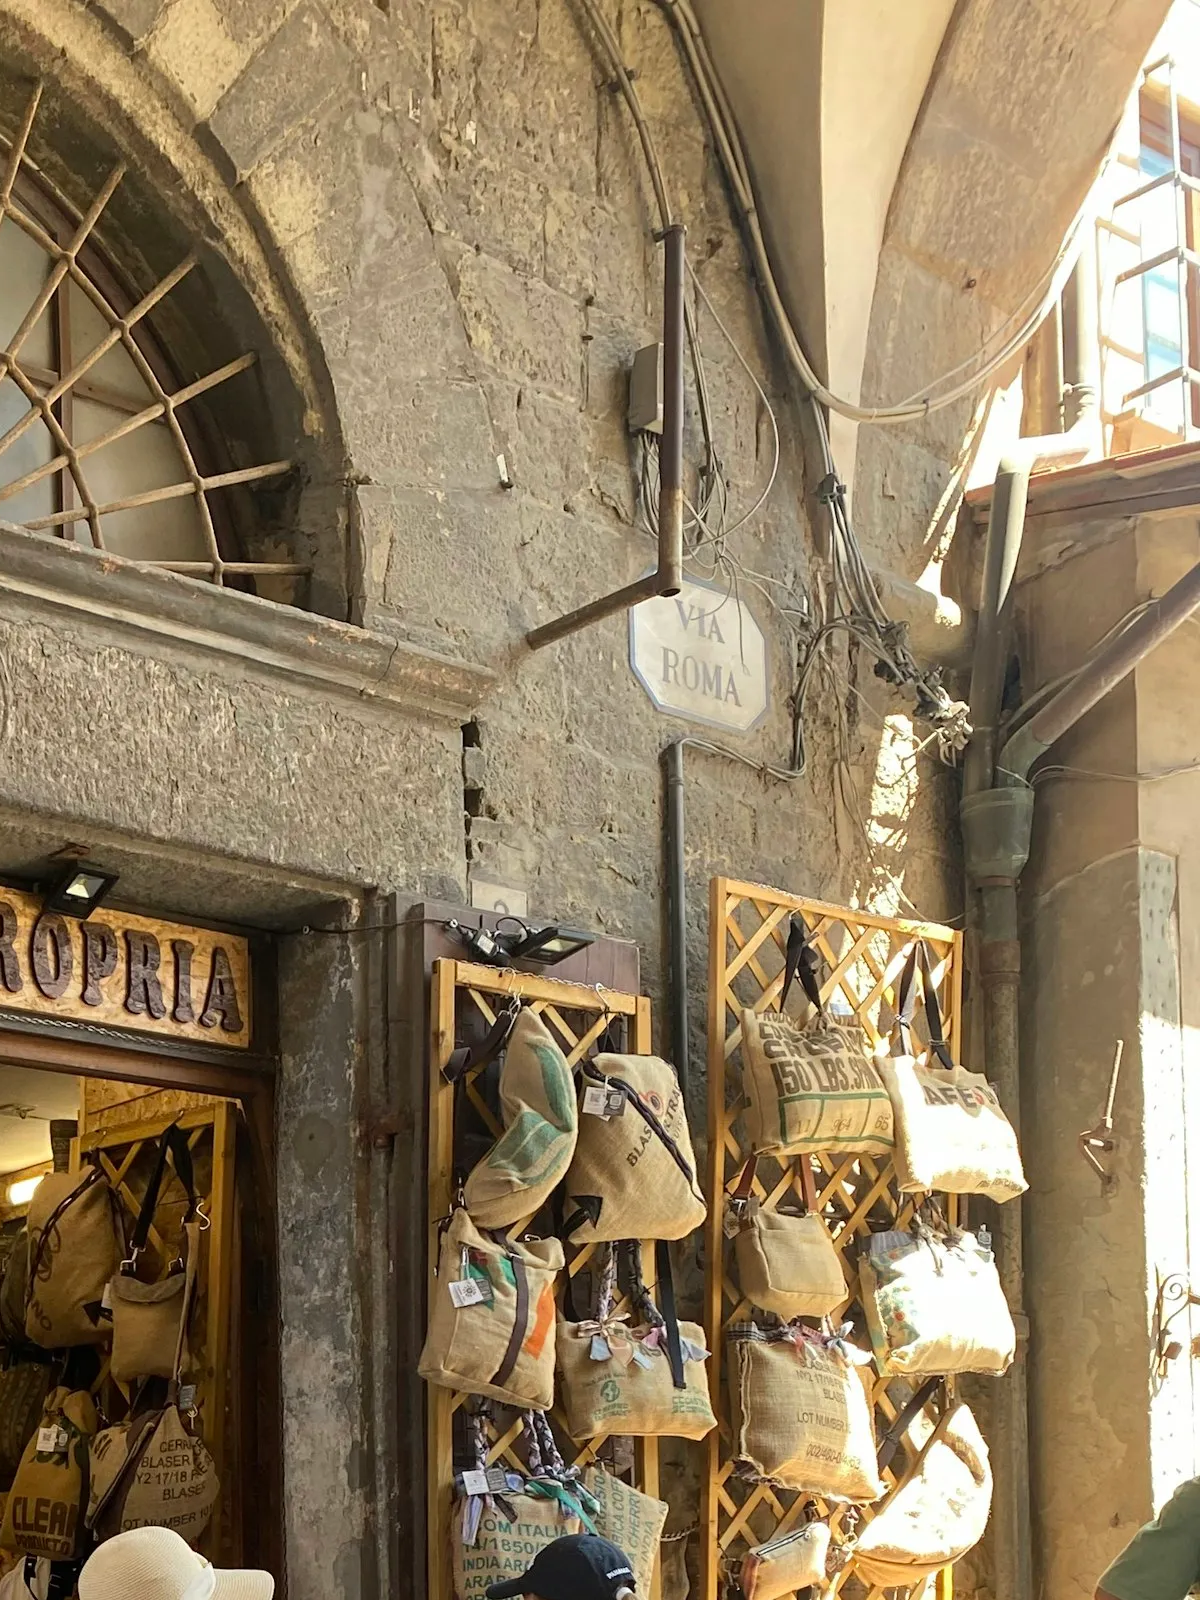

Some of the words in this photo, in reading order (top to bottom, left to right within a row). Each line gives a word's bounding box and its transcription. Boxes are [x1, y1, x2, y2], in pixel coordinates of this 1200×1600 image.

[673, 598, 726, 645] VIA
[659, 646, 743, 708] ROMA
[141, 1454, 191, 1469] BLASER
[517, 1523, 569, 1538] ITALIA
[462, 1556, 500, 1572] INDIA
